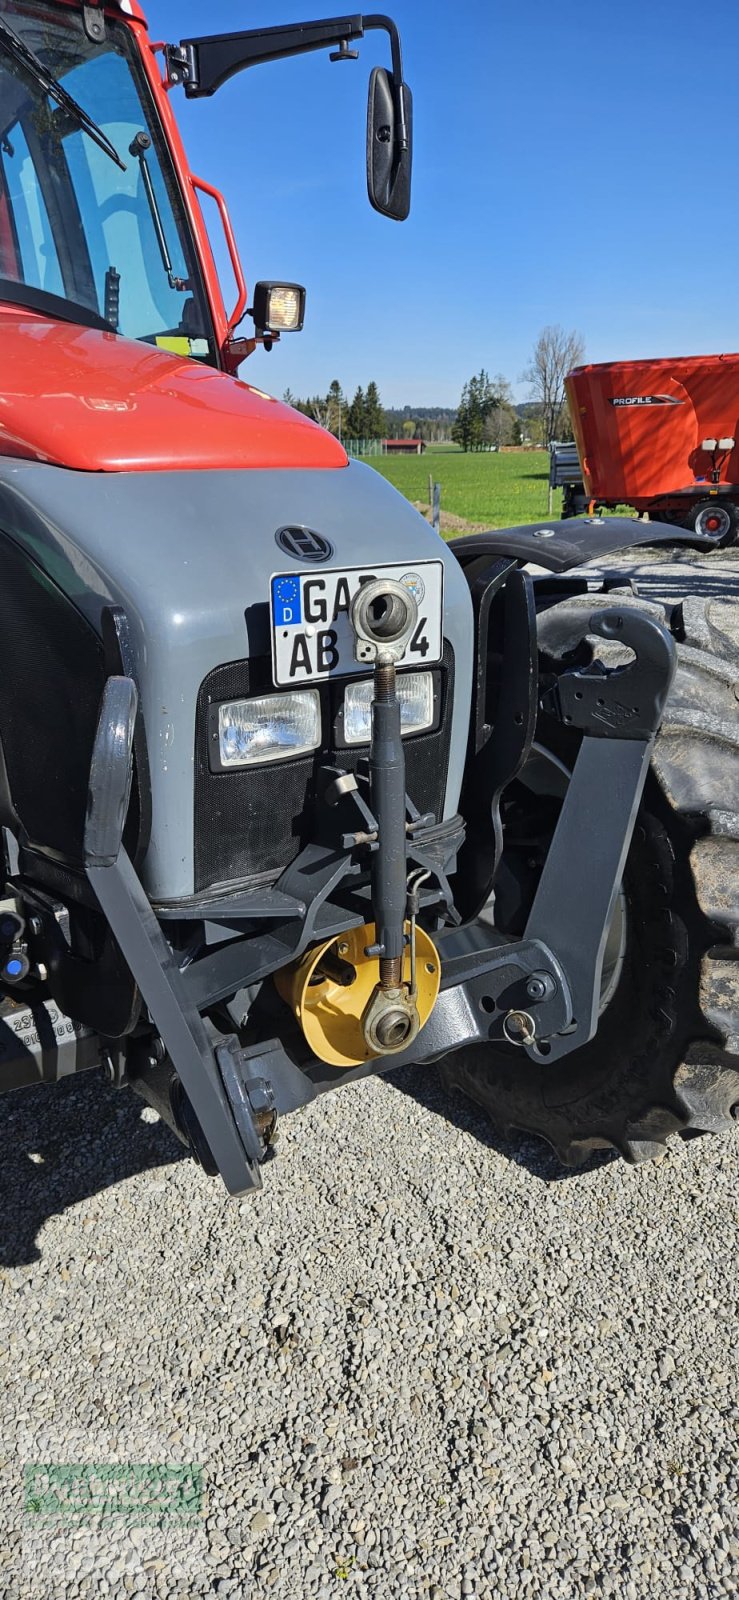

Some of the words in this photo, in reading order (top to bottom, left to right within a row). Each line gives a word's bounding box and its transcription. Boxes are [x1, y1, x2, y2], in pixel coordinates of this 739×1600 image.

[613, 396, 652, 405] PROFILE
[283, 607, 293, 623] D
[303, 574, 377, 624] GA
[289, 629, 340, 677] AB
